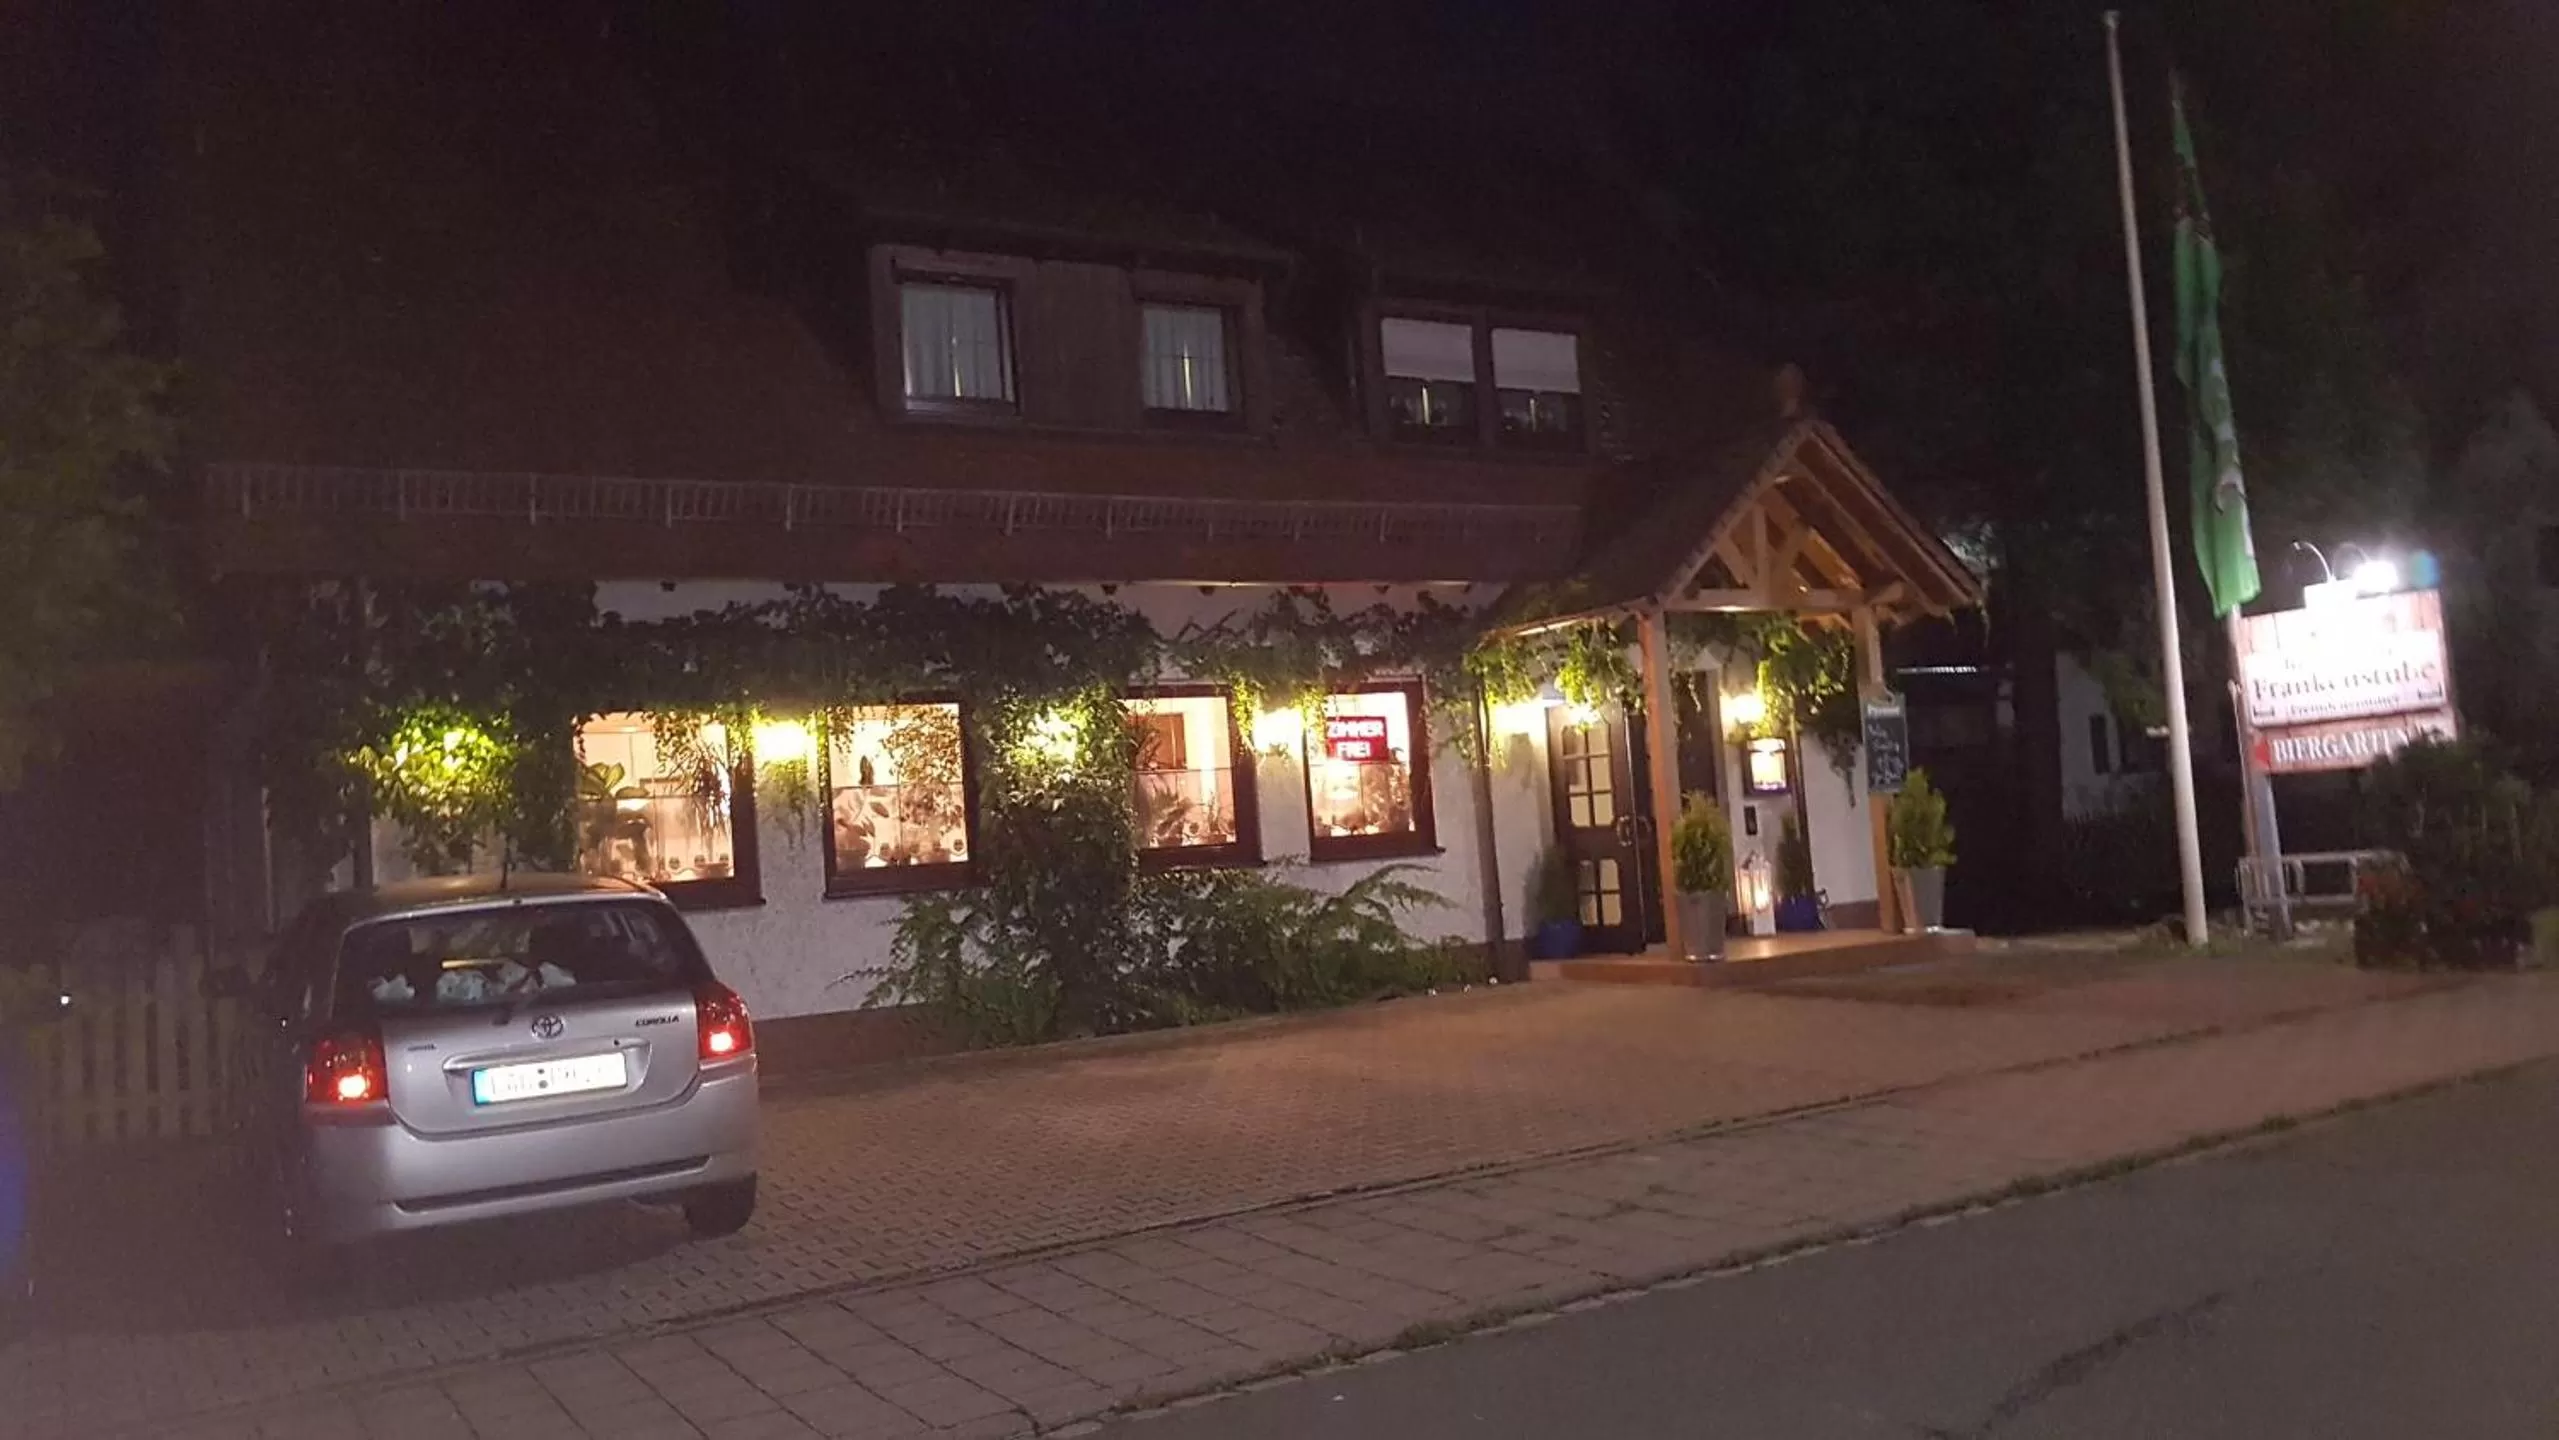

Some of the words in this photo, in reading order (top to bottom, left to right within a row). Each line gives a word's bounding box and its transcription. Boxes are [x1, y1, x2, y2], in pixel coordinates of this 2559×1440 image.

[1327, 721, 1384, 737] ZIMMER
[1338, 742, 1370, 757] FREI
[2273, 728, 2410, 763] BIERGARTEN
